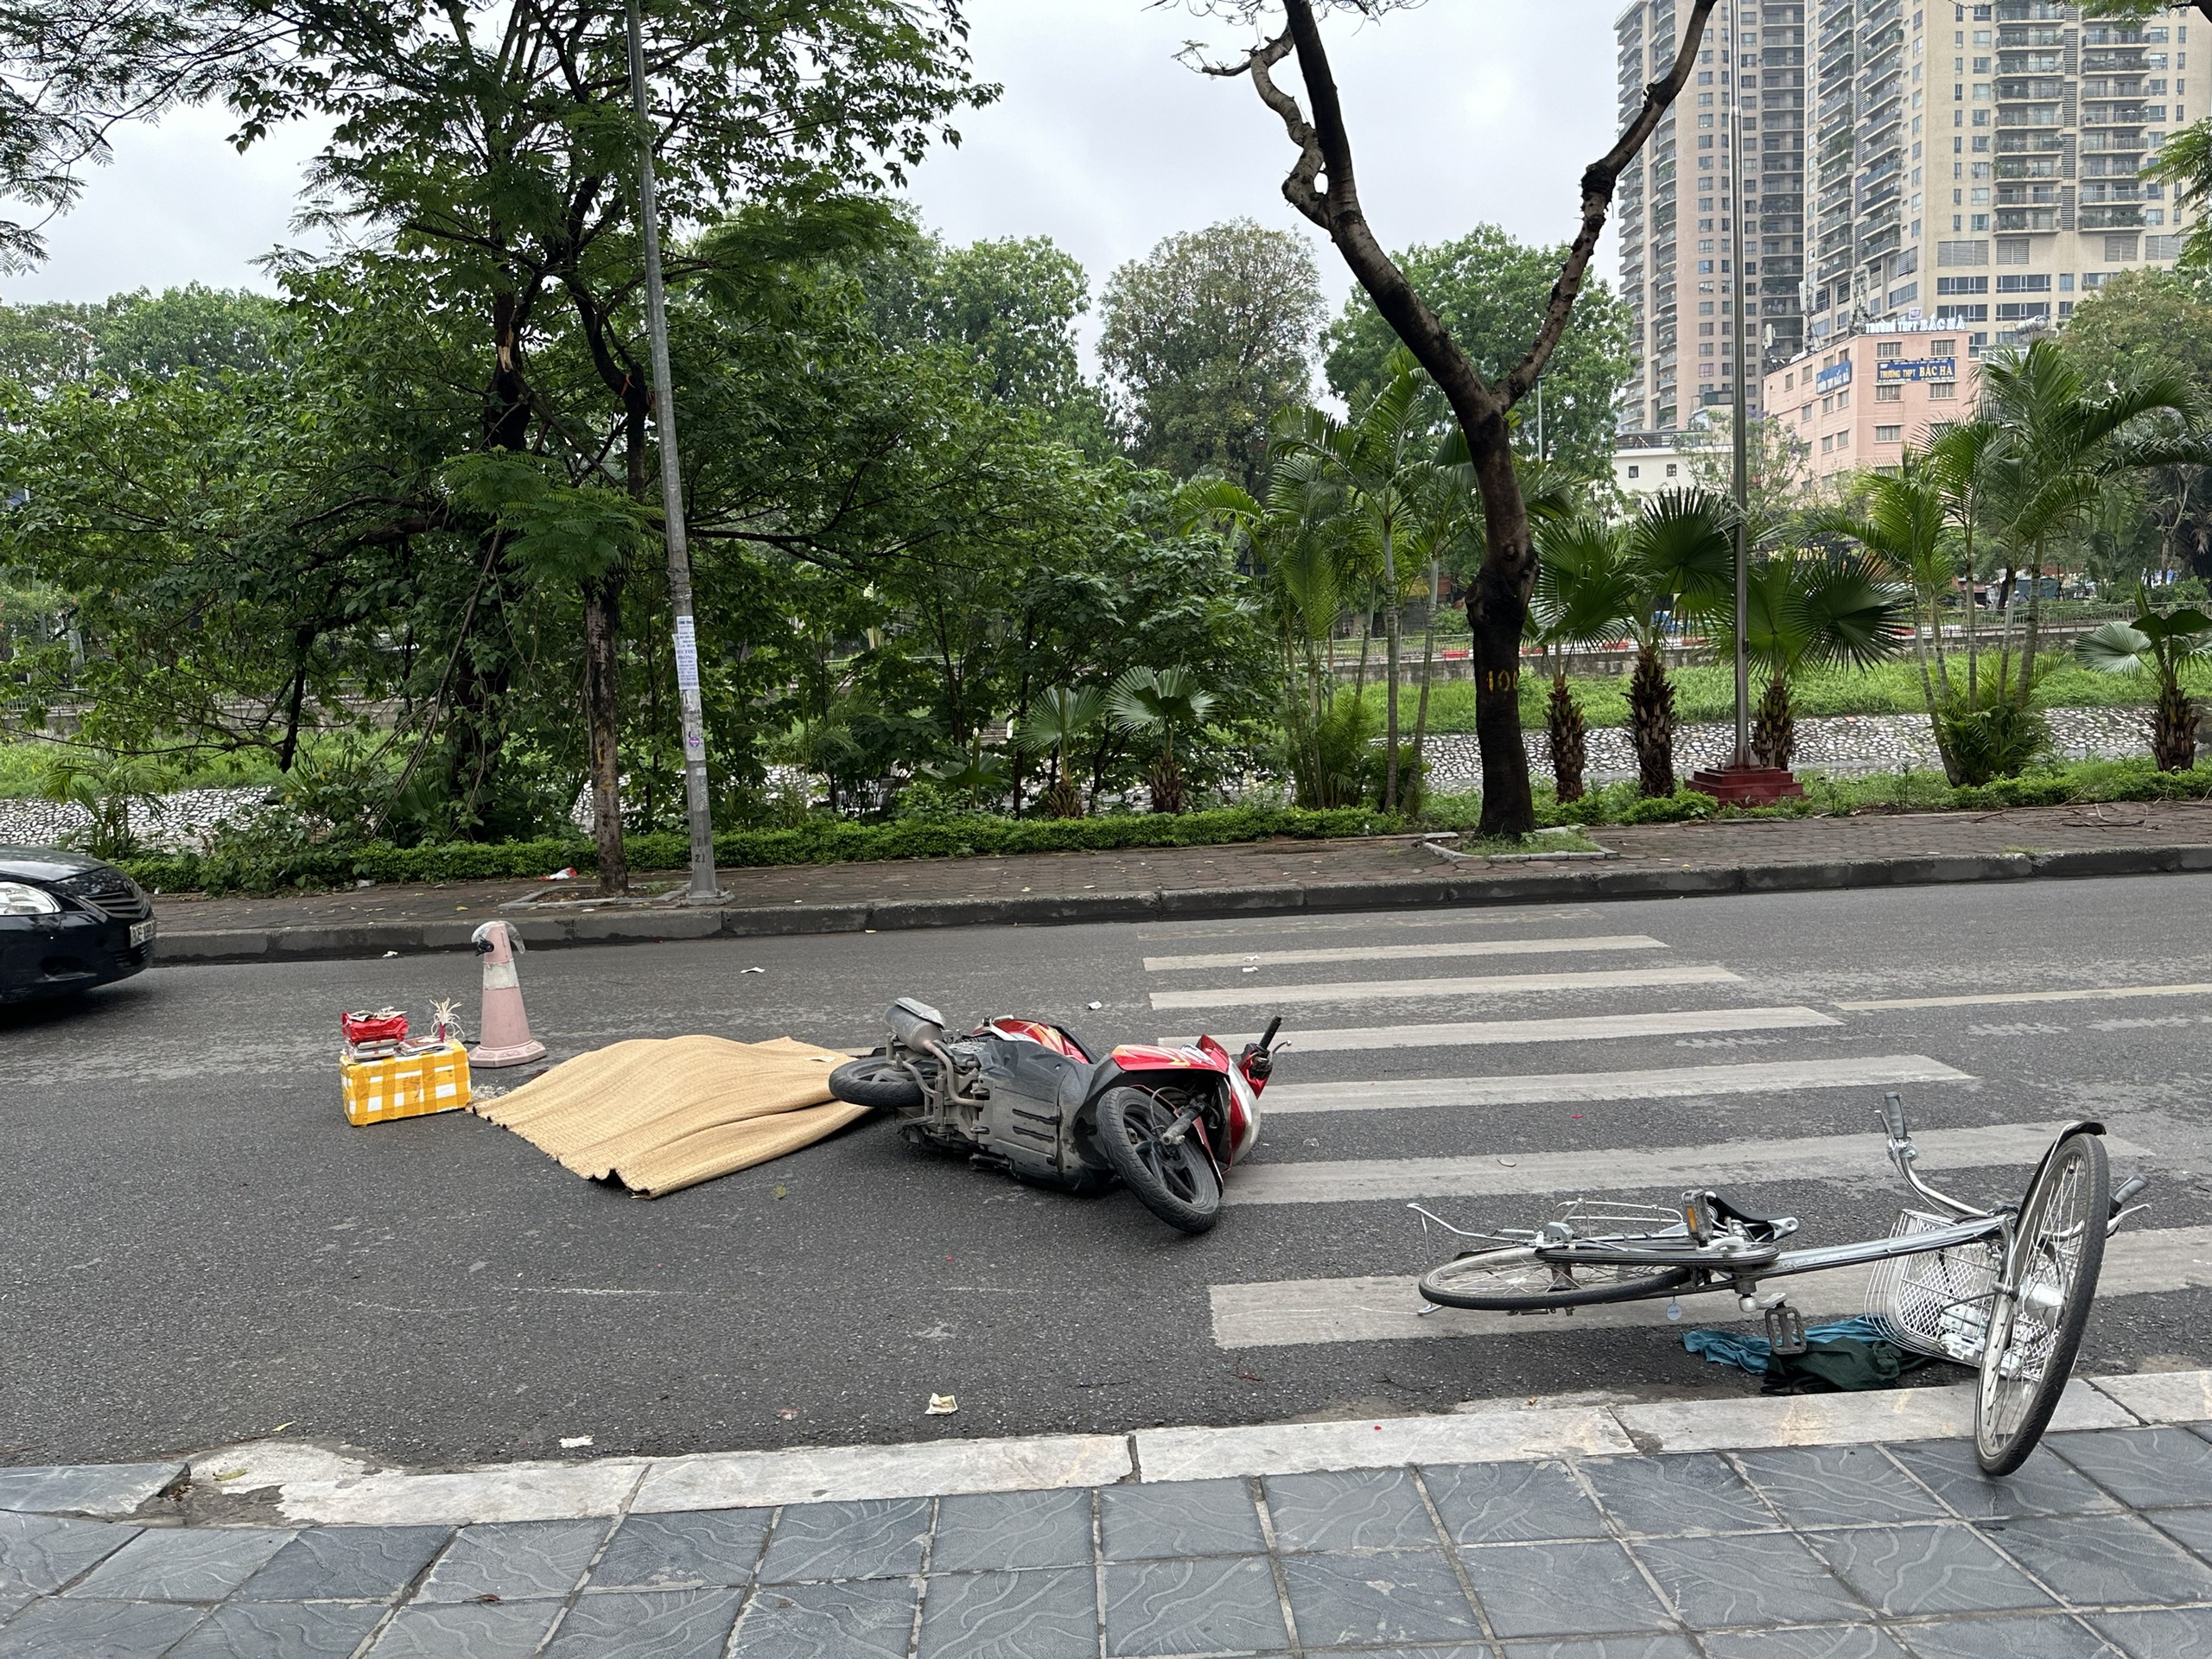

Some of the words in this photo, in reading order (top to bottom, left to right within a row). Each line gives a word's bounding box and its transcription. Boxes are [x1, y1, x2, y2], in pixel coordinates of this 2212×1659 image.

[1897, 321, 1917, 332] THPT
[1879, 368, 1900, 378] TRƯỜNG
[1903, 369, 1916, 378] THPT
[1940, 363, 1953, 376] HÀ
[695, 853, 705, 863] 21
